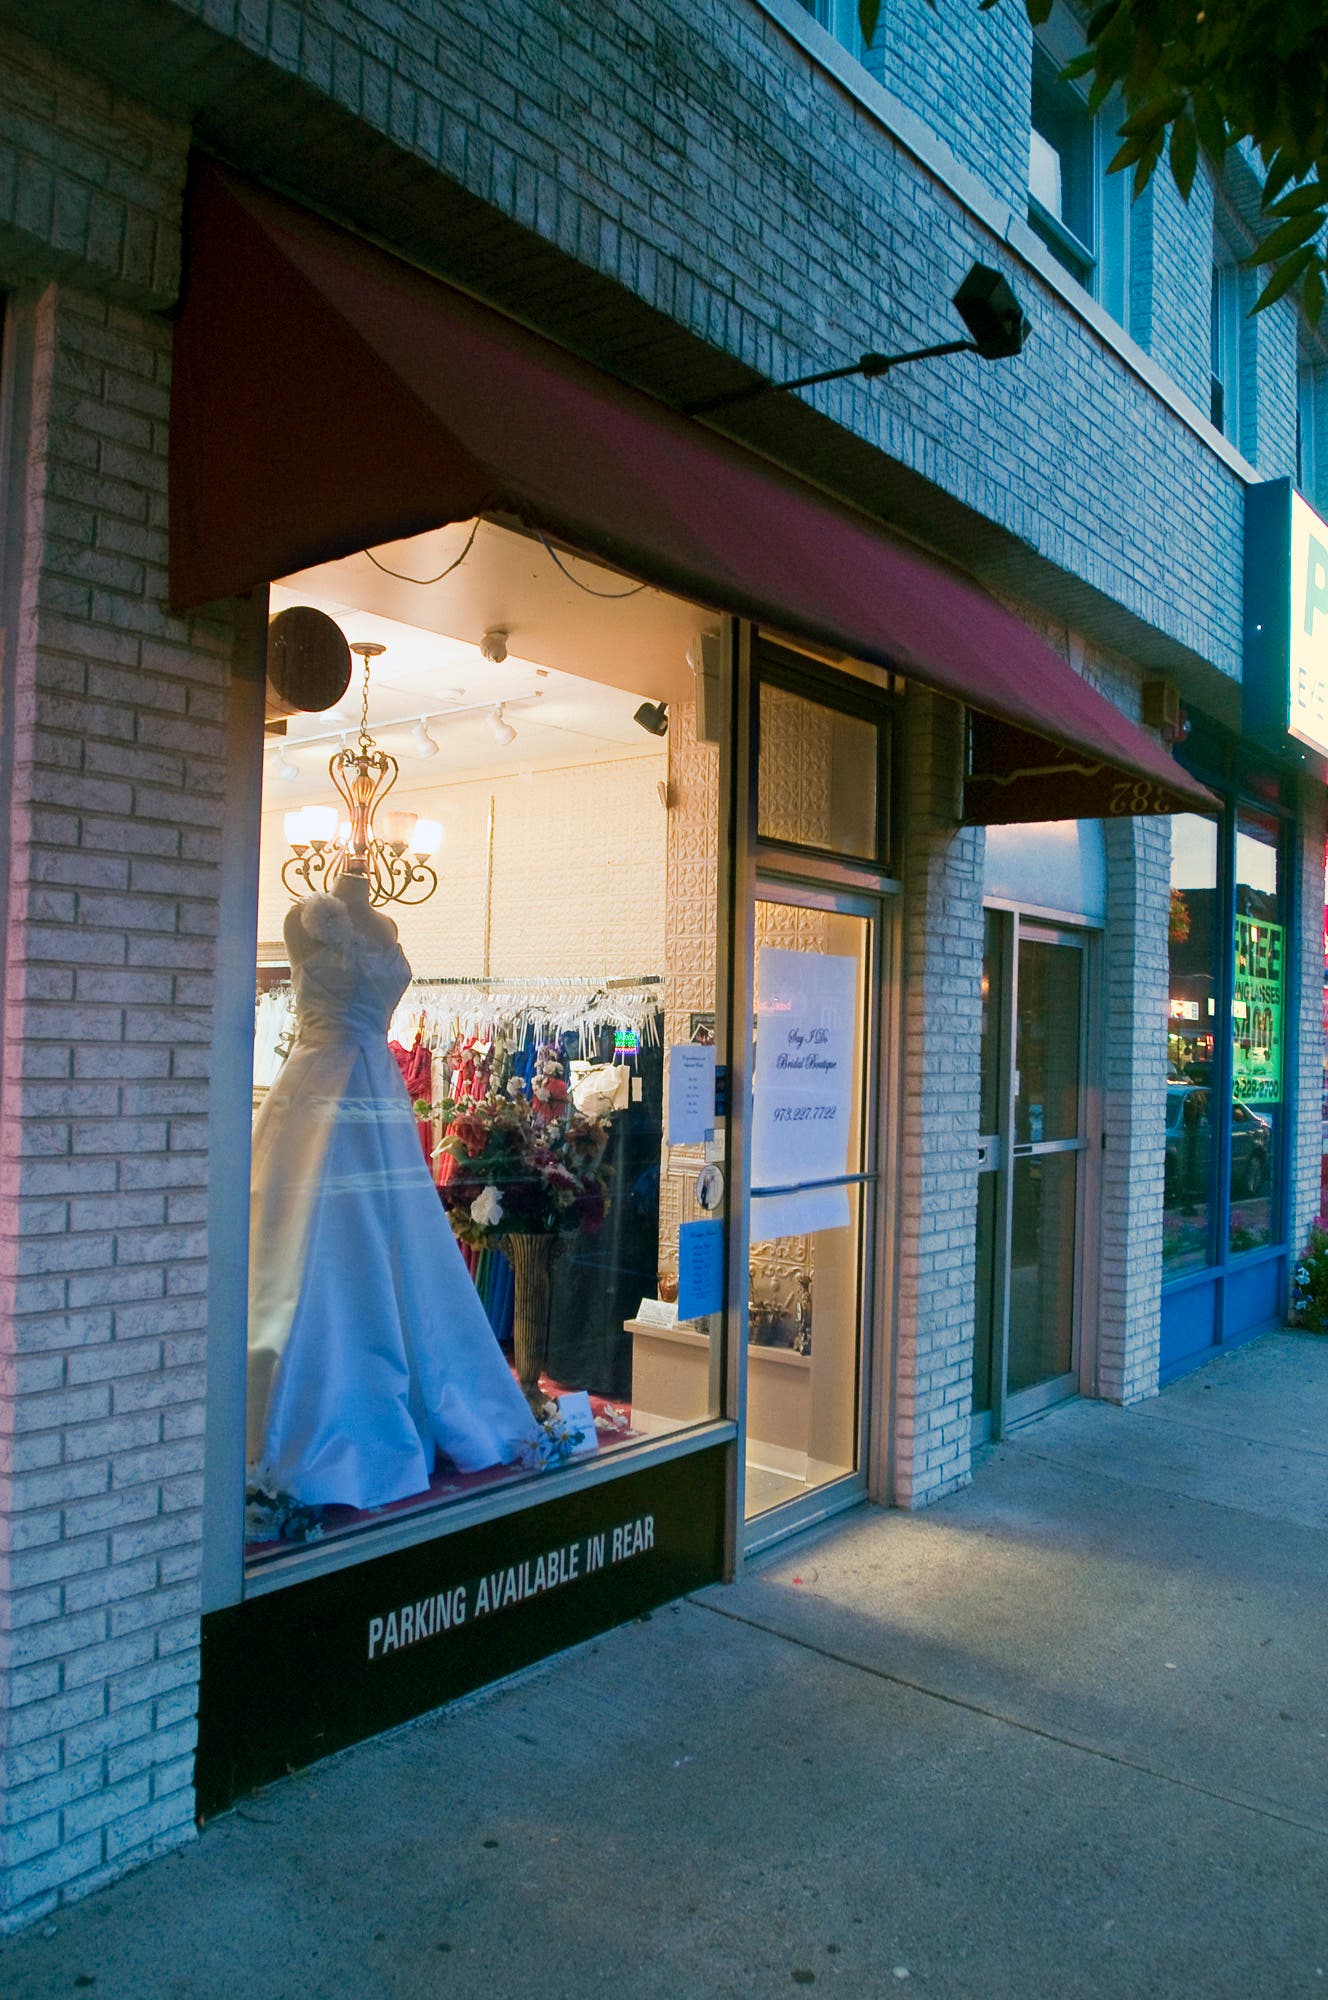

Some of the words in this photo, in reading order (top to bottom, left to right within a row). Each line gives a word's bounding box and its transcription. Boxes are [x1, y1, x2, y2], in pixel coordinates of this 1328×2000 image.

[776, 1052, 804, 1070] Bridal
[773, 1106, 837, 1121] 973.227.7722
[367, 1586, 466, 1659] PARKING
[474, 1543, 580, 1616] AVAILABLE
[586, 1532, 605, 1573] IN
[611, 1515, 655, 1562] REAR
